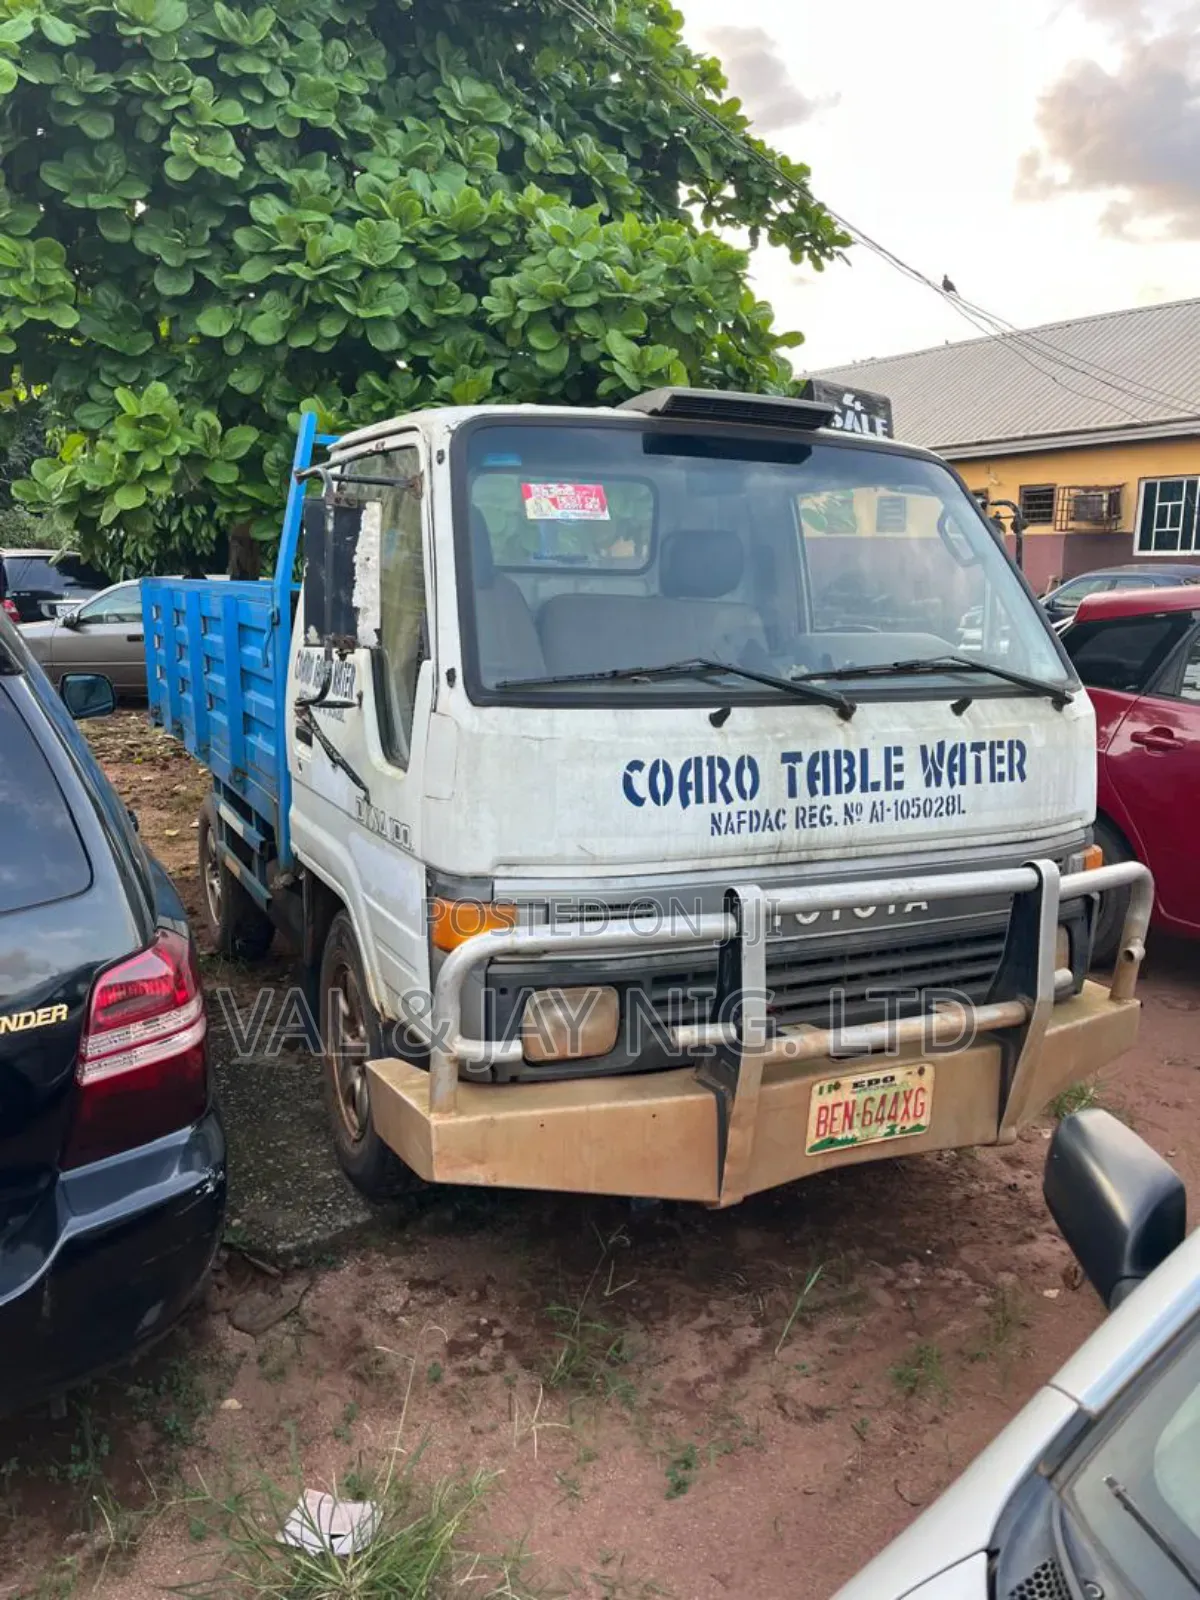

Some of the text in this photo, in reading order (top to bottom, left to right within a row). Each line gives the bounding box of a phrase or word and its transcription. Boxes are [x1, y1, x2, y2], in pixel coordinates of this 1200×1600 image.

[842, 393, 865, 411] 4
[831, 405, 889, 437] SALE
[622, 739, 1027, 810] COARO TABLE WATER
[710, 808, 787, 836] NAFDAC
[795, 801, 838, 829] REG.
[815, 1086, 926, 1139] BEN-644XG
